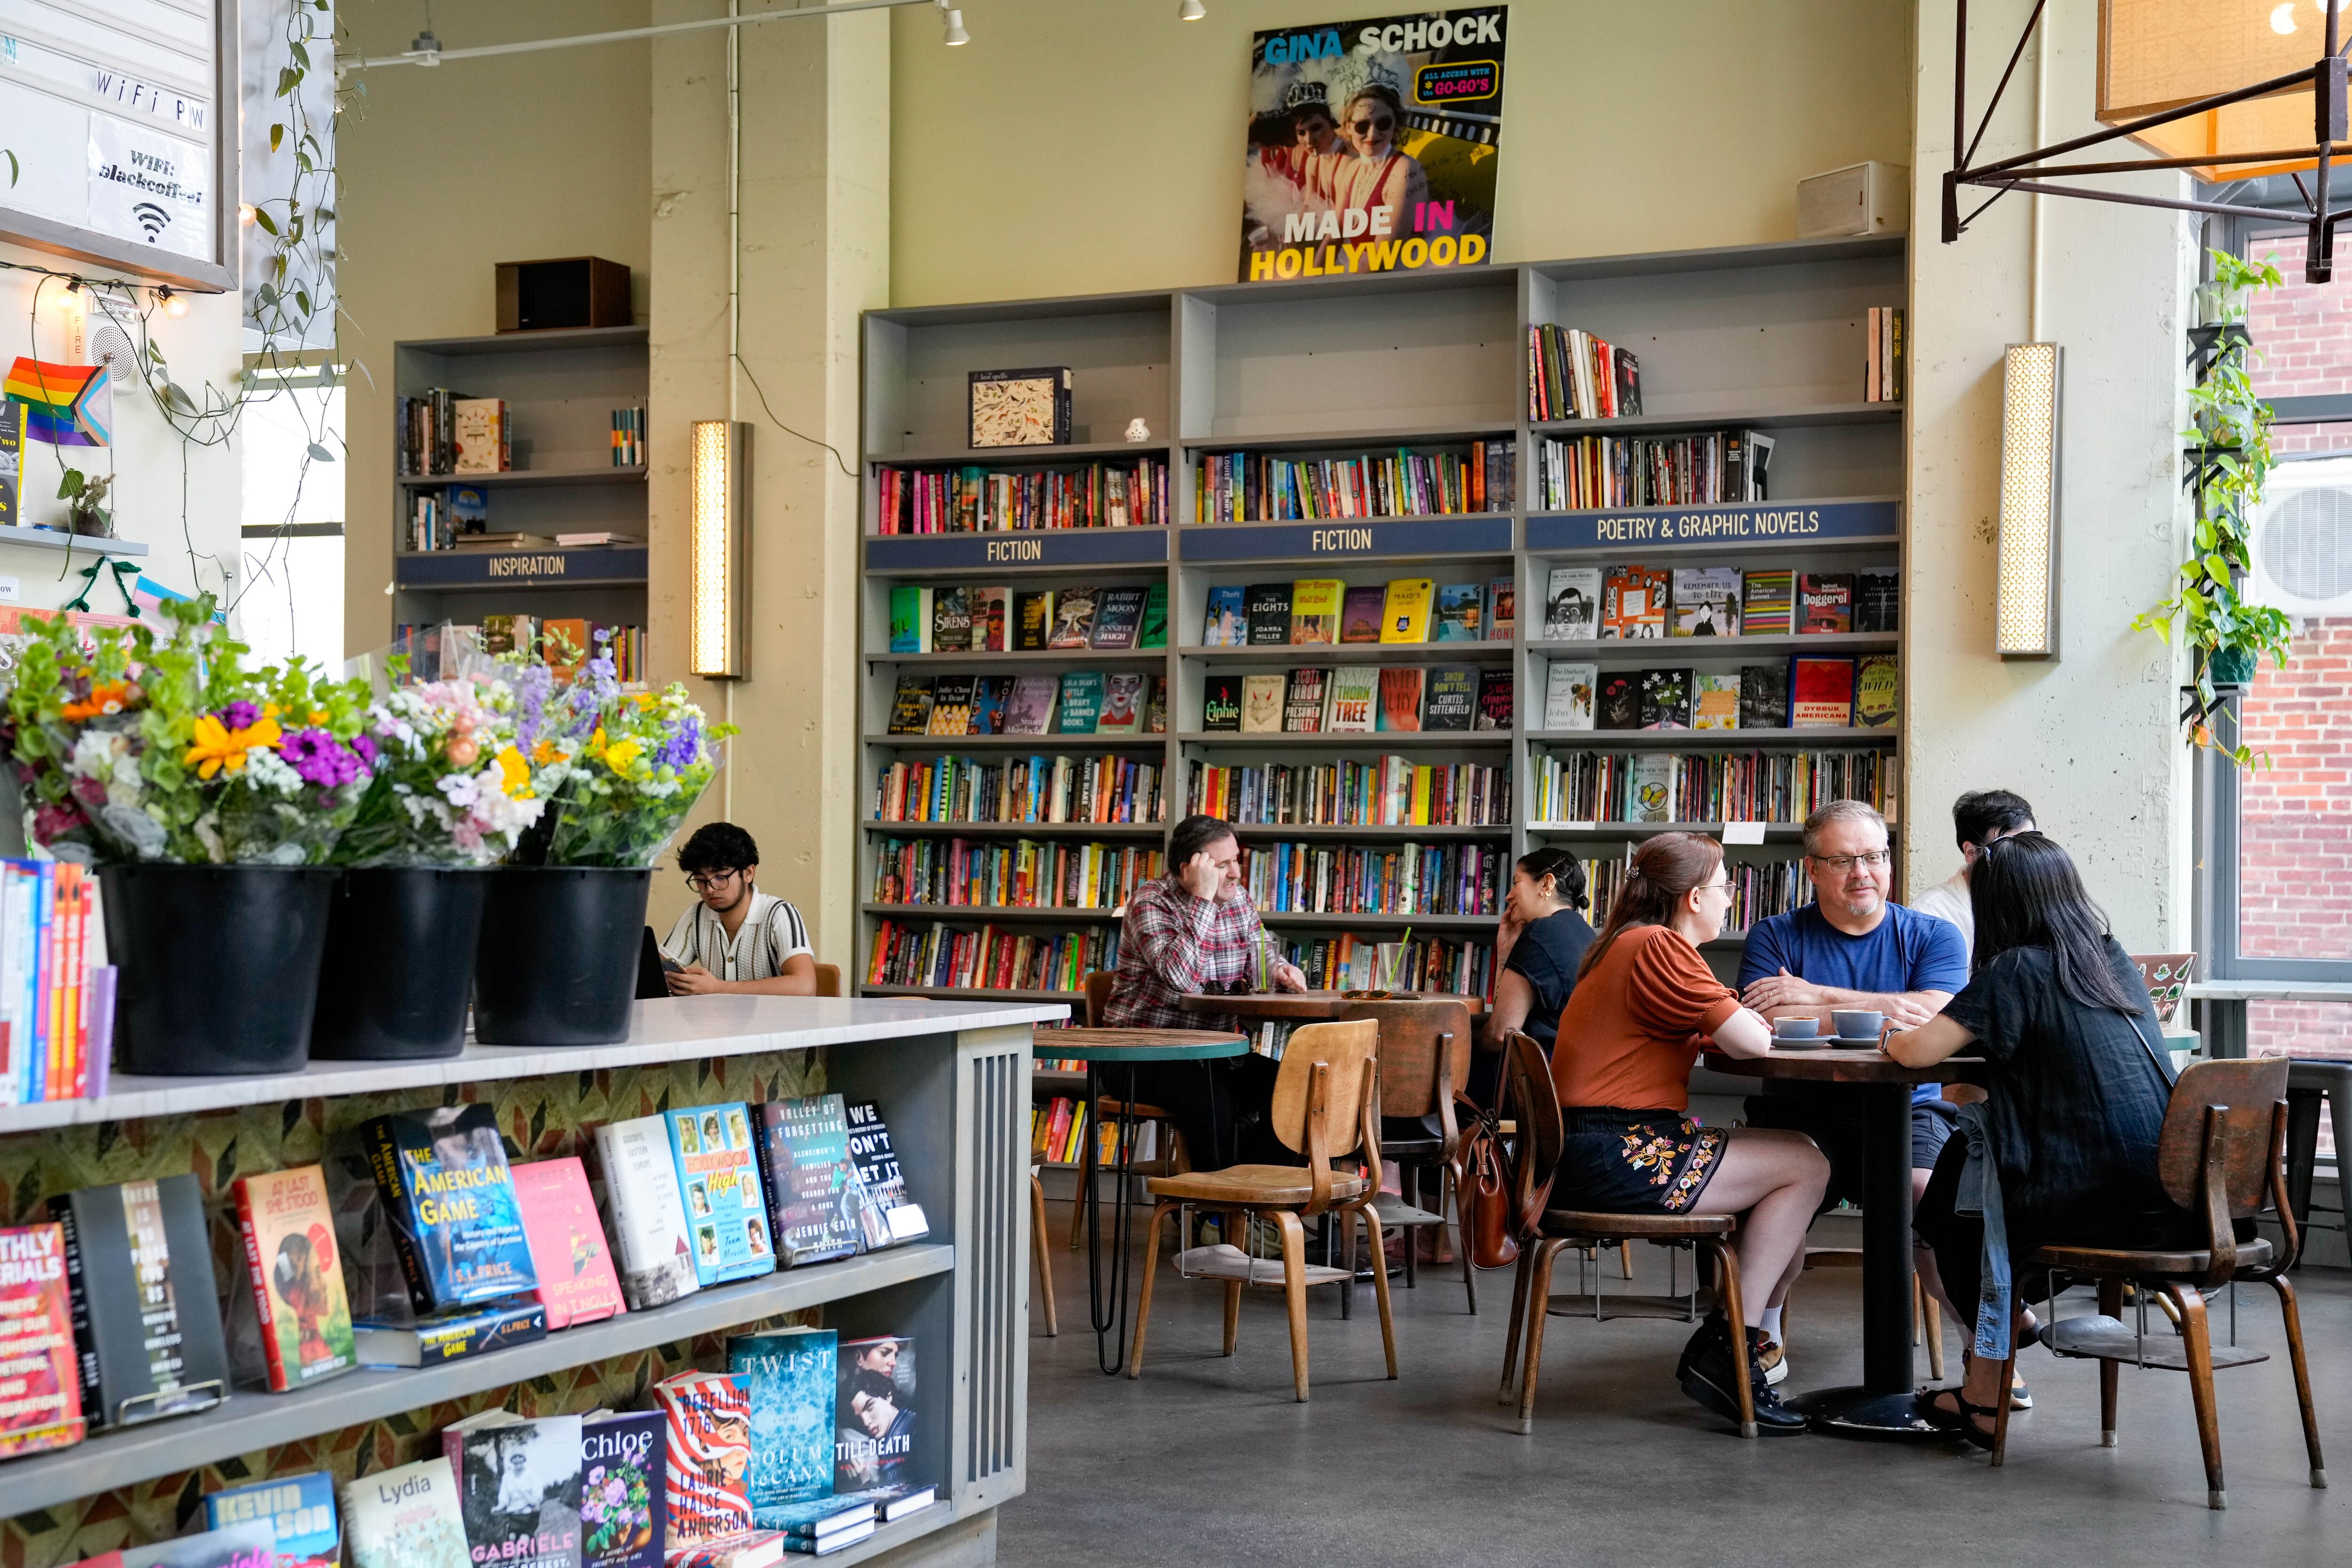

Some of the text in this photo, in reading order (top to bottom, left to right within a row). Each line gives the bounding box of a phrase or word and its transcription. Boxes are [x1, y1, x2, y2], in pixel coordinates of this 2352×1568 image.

[1265, 14, 1502, 65] GINA SCHOCK
[1440, 70, 1469, 79] ACCESS
[1470, 68, 1490, 76] WITH
[97, 71, 158, 112] WiFi
[1435, 78, 1489, 96] GO-GO'S
[130, 149, 175, 177] WIFI:
[1284, 200, 1454, 243] MADE IN
[1249, 234, 1486, 282] HOLLYWOOD
[1597, 510, 1820, 541] POETRY & GRAPHIC NOVELS
[1312, 528, 1372, 551] FICTION
[987, 540, 1041, 562] FICTION
[489, 556, 565, 577] INSPIRATION
[1683, 581, 1720, 590] REMEMBER
[1705, 590, 1722, 599] LIFE
[1107, 592, 1142, 602] RABBIT
[1803, 593, 1847, 607] Doggerel
[1105, 604, 1136, 613] MOON
[1252, 603, 1289, 612] EIGHTS
[934, 613, 970, 632] SIRENS
[1295, 670, 1320, 685] SCOTT
[1443, 671, 1465, 682] SHOW
[1289, 684, 1322, 700] TUROW
[1337, 685, 1371, 700] THORN
[1434, 682, 1471, 692] DON'T TELL
[1864, 681, 1894, 692] WILD
[1438, 694, 1464, 705] CURTIS
[1070, 708, 1095, 716] BANNED
[1206, 700, 1240, 723] Elphie
[1285, 706, 1320, 718] PRESUMED
[1335, 702, 1369, 723] TREE
[1429, 704, 1470, 715] SITTENFELD
[1548, 708, 1568, 717] John
[1287, 718, 1315, 732] GUILTY
[1547, 719, 1579, 727] Kinsella
[1081, 757, 1092, 805] OLIVIE BLAKE
[1312, 946, 1324, 973] FEARLESS
[779, 1103, 835, 1120] VALLEY OF
[849, 1104, 877, 1124] WE
[778, 1120, 842, 1139] FORGETTING
[850, 1132, 890, 1155] ON'T
[405, 1147, 432, 1165] THE
[633, 1159, 652, 1171] EUROPE
[688, 1151, 748, 1172] HOLLYWOOD
[801, 1161, 831, 1171] FAMILIES
[859, 1161, 901, 1183] ET IT
[272, 1175, 310, 1197] AT LAST
[414, 1165, 508, 1196] AMERICAN
[707, 1164, 739, 1197] High
[805, 1176, 818, 1185] AND
[287, 1190, 318, 1211] STOOD
[801, 1186, 840, 1199] SEARCH FOR
[419, 1198, 479, 1226] GAME
[795, 1218, 856, 1239] JENNIE ERIN
[724, 1235, 740, 1247] Teen
[477, 1261, 512, 1278] PRICE
[146, 1285, 165, 1304] US
[552, 1273, 608, 1297] SPEAKING
[553, 1301, 568, 1316] IN
[442, 1341, 467, 1358] GAME
[741, 1350, 832, 1375] TWIST
[683, 1388, 750, 1413] REBELLION
[682, 1414, 711, 1437] 1776
[581, 1429, 653, 1461] Chloe
[835, 1433, 910, 1461] TILL DEATH
[680, 1466, 727, 1493] LAURIE
[751, 1464, 827, 1488] cCANN
[379, 1475, 431, 1504] Lydia
[216, 1483, 302, 1524] KEVIN
[679, 1492, 721, 1515] HALSE
[676, 1511, 748, 1538] ANDERSON
[471, 1530, 574, 1562] GABRIËLE
[606, 1547, 625, 1557] NOVEL
[591, 1557, 615, 1568] SECRETS
[616, 1555, 629, 1564] AND
